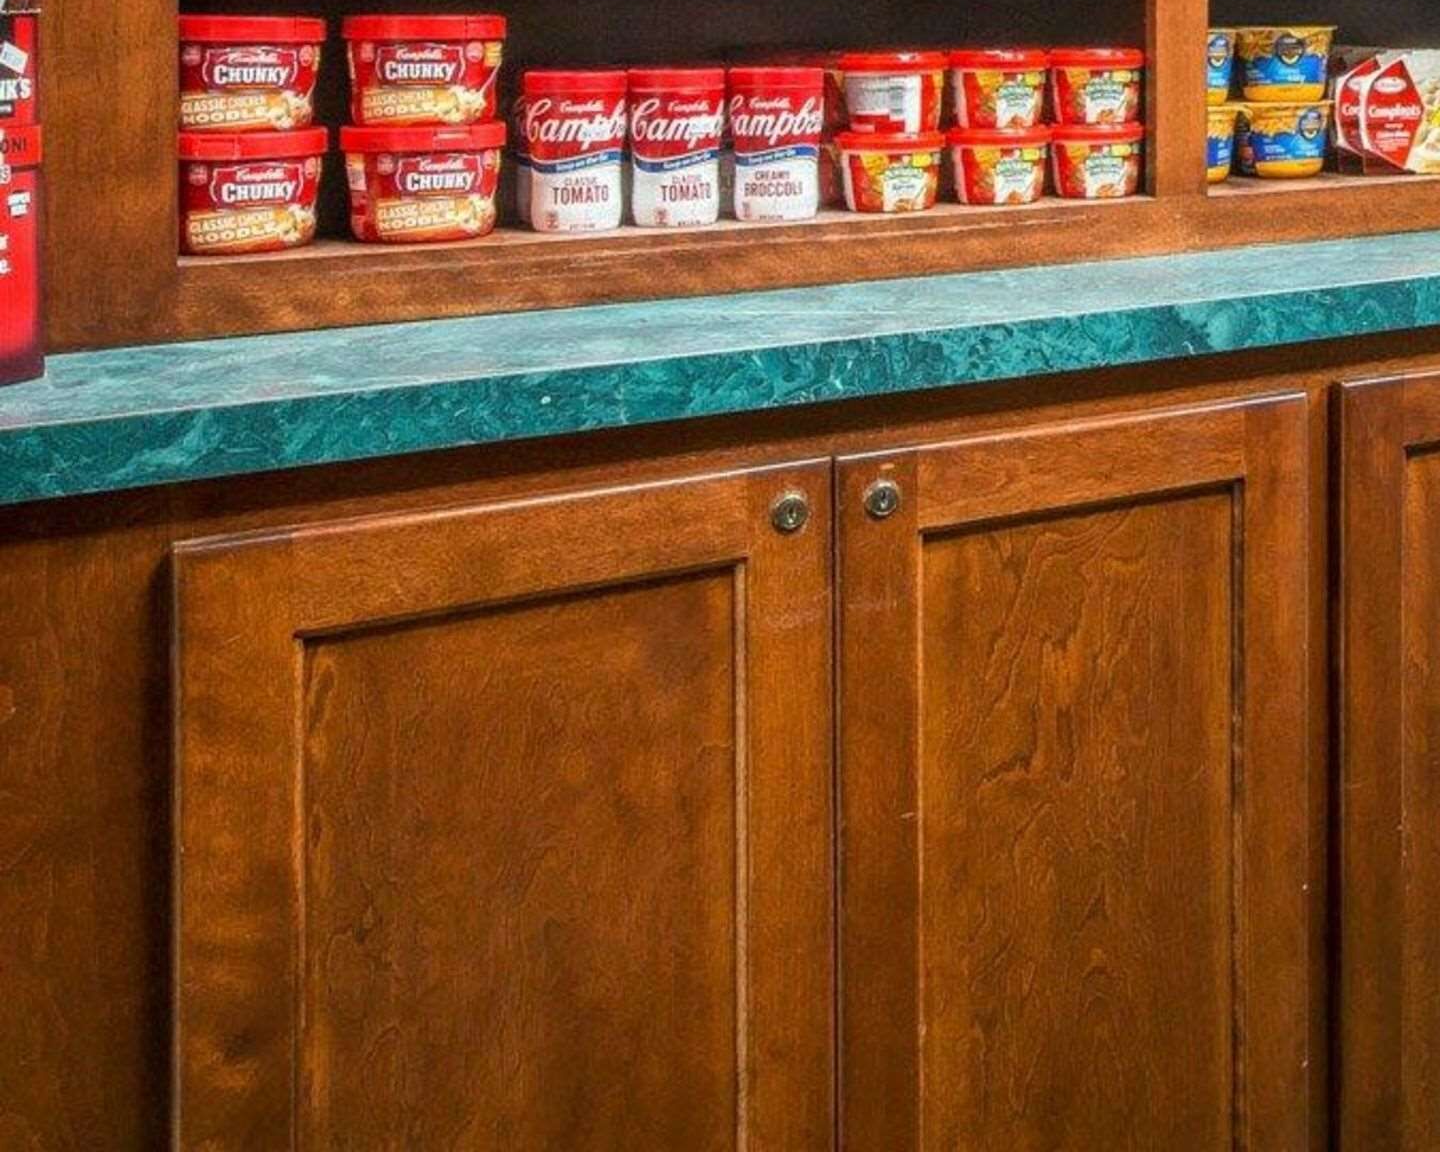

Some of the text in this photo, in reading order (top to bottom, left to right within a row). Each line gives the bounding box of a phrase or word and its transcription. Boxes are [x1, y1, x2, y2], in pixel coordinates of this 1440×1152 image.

[213, 64, 290, 87] CHUNKY
[384, 60, 456, 82] CHUNKY
[220, 179, 297, 204] CHUNKY
[405, 170, 475, 191] CHUNKY
[744, 180, 804, 199] BROCCOLI
[552, 184, 610, 206] TOMATO
[660, 181, 713, 203] TOMATO
